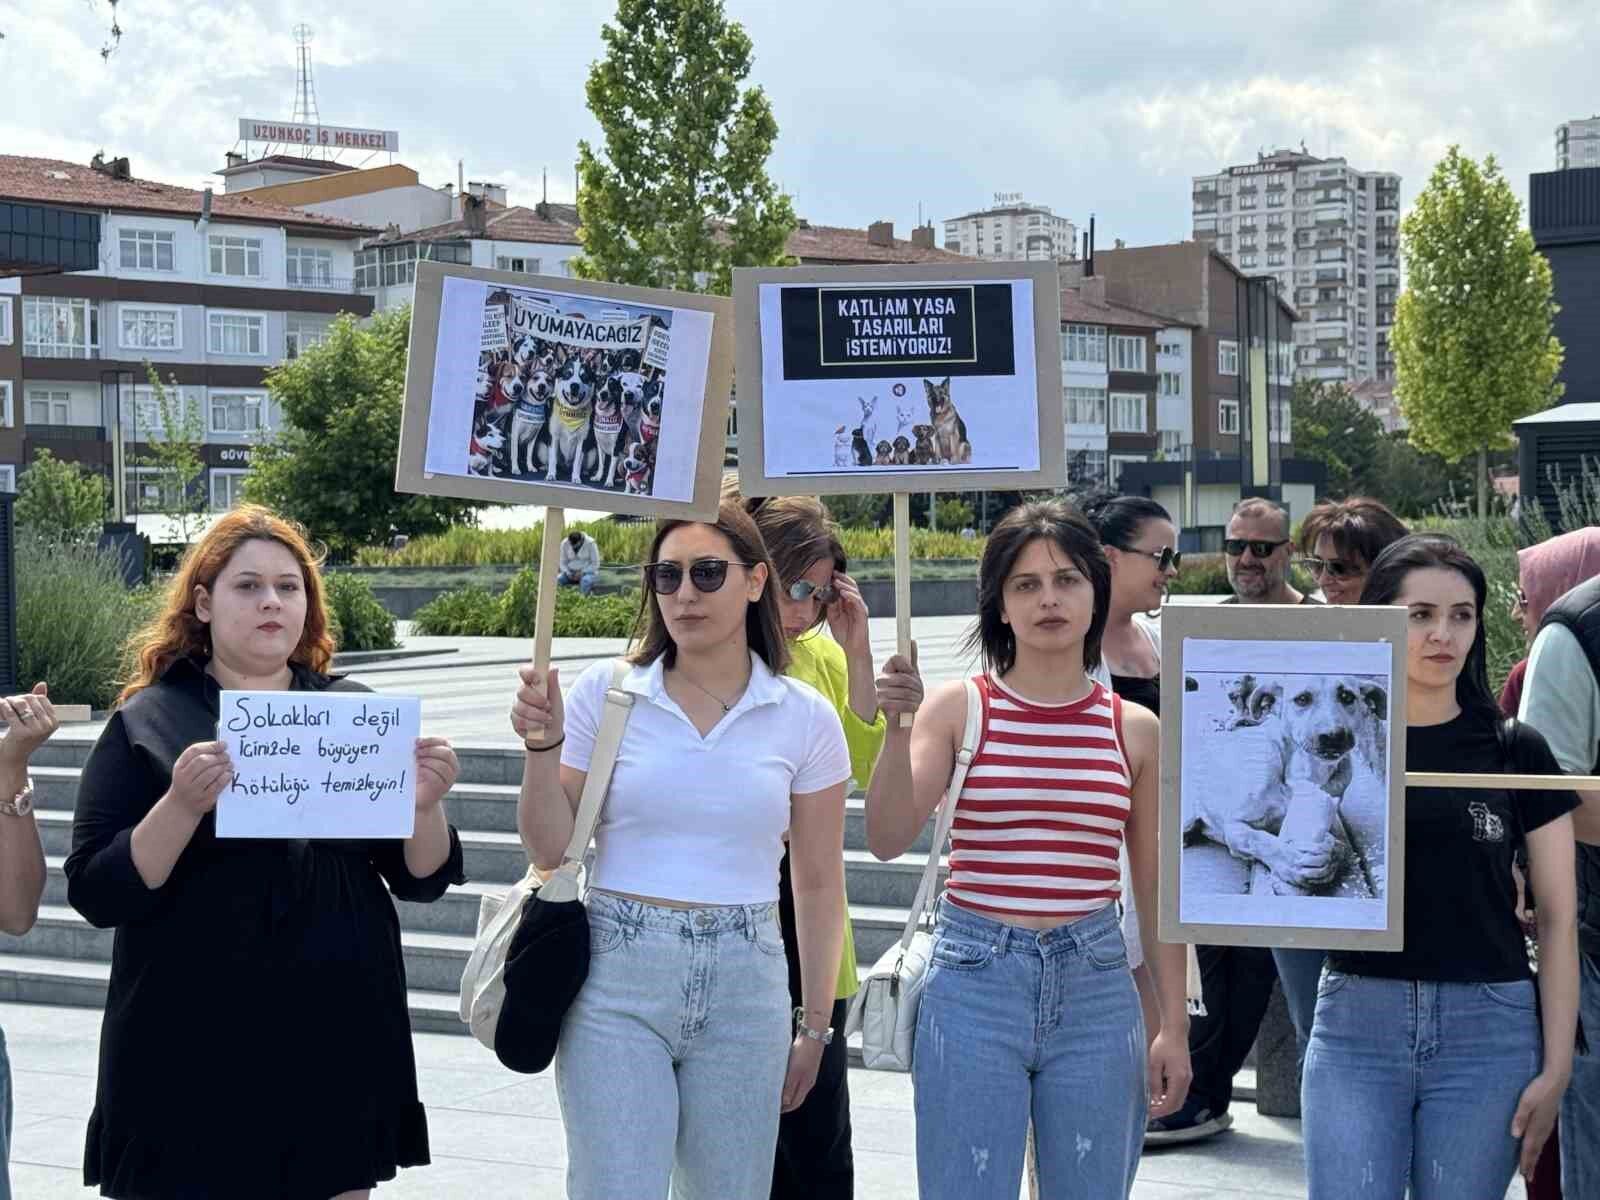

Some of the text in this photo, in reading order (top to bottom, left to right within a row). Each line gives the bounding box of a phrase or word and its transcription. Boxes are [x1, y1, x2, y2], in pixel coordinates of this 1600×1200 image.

[913, 297, 956, 315] YASA
[852, 317, 944, 337] TASARILARI
[227, 697, 400, 737] Sokakları değil
[318, 737, 380, 764] büyüyen
[320, 769, 406, 802] temizleyin!
